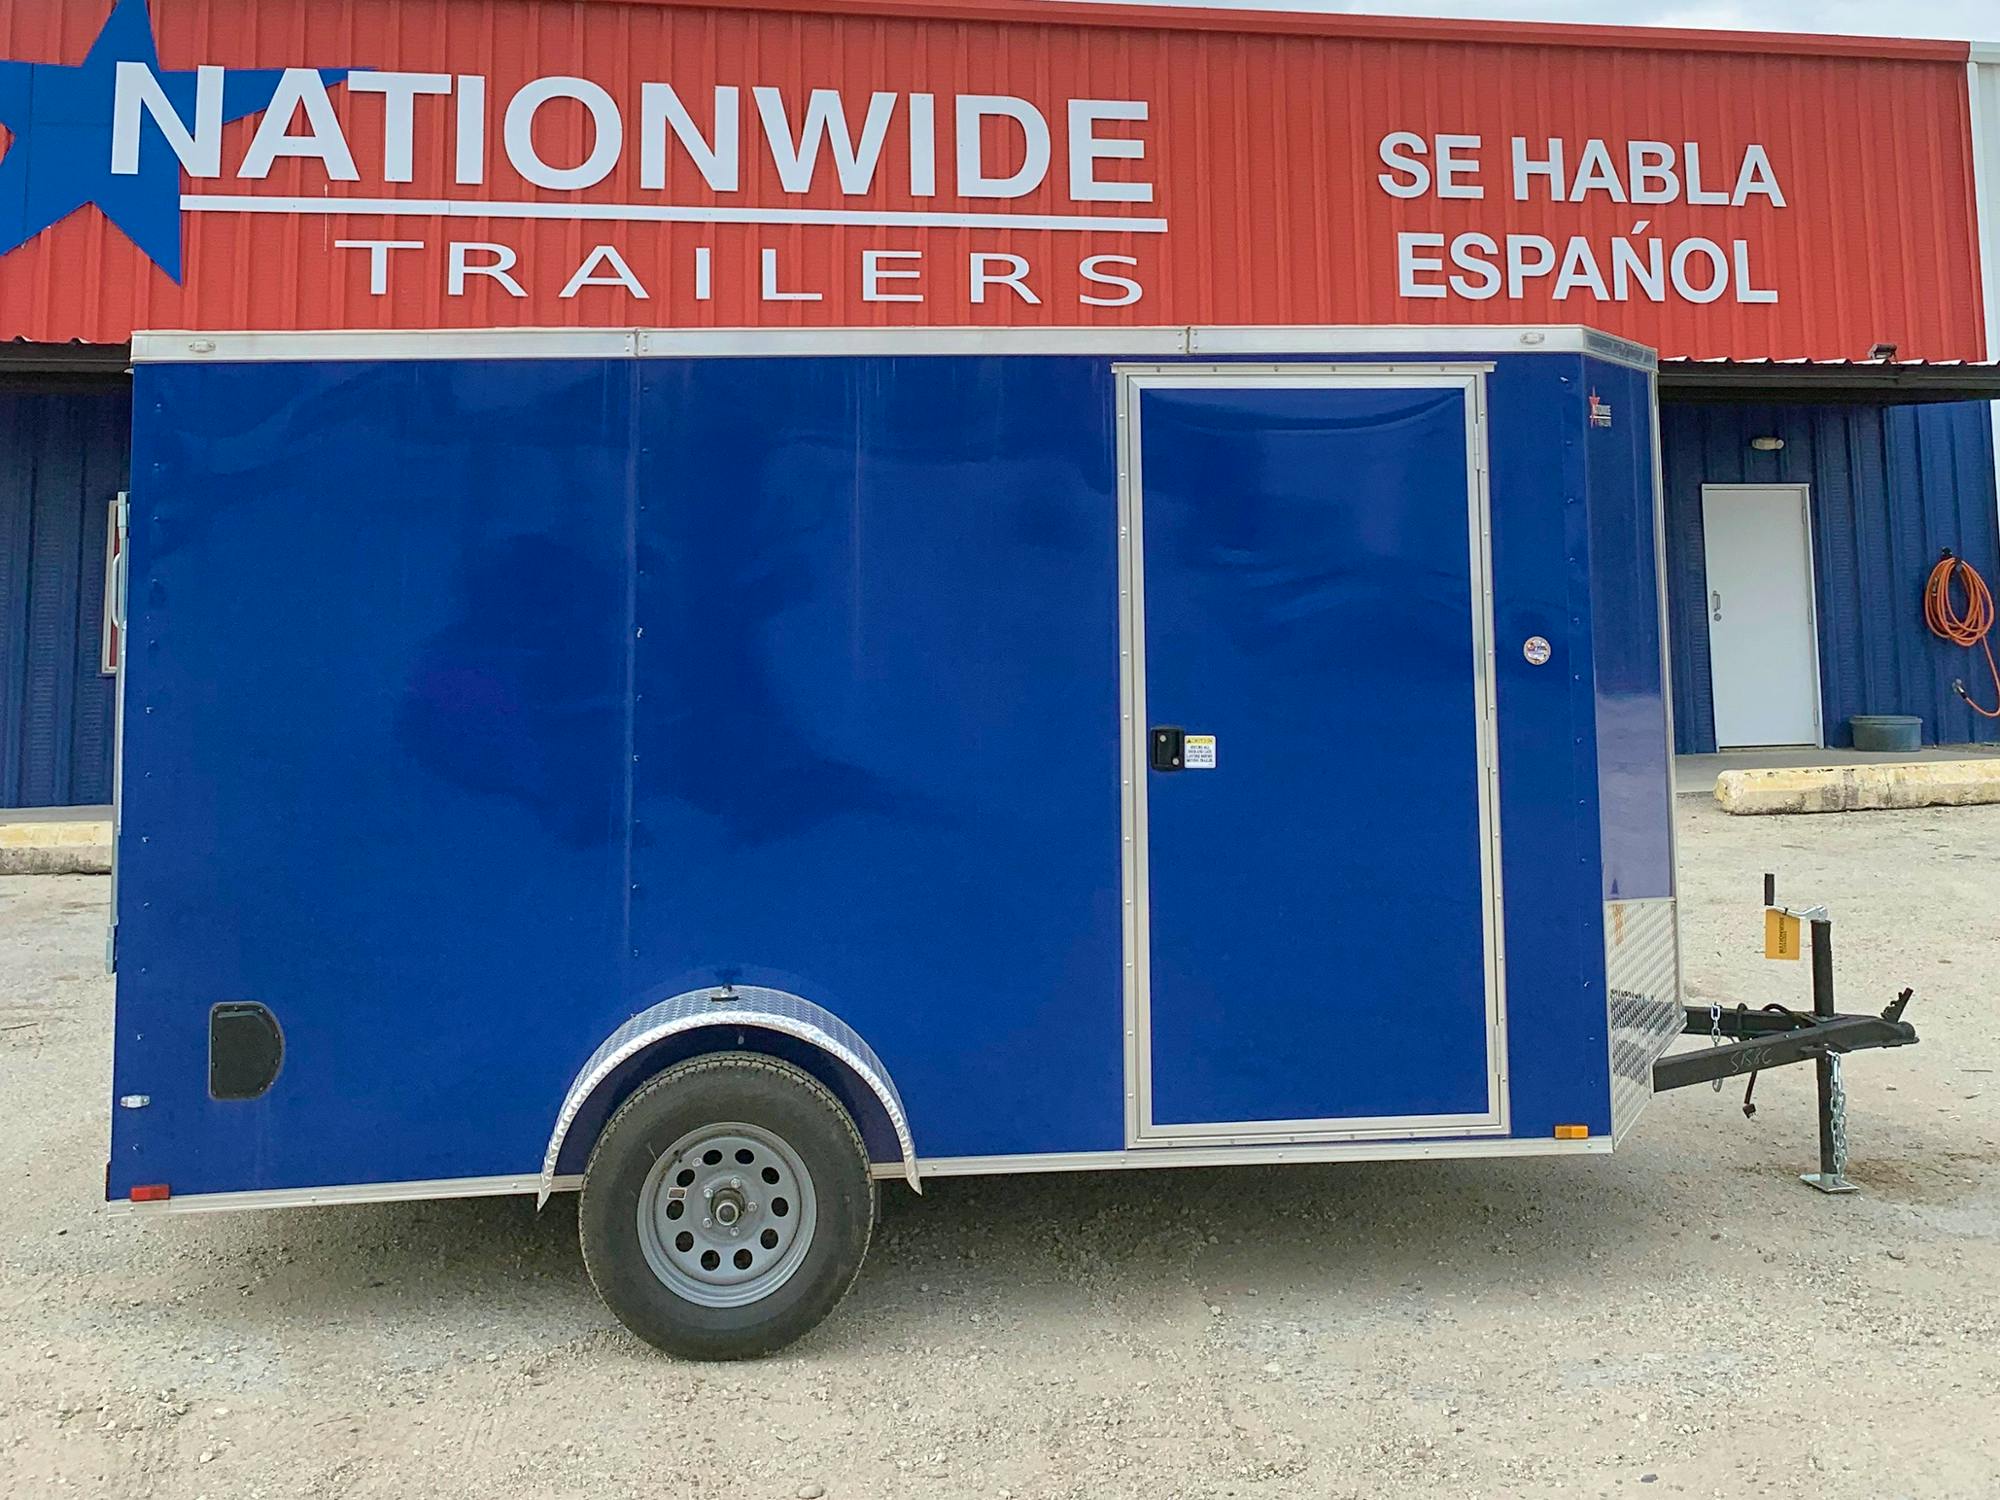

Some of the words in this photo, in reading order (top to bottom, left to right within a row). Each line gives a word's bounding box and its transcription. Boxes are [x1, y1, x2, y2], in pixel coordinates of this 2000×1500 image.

[111, 61, 1153, 202] NATIONWIDE
[1378, 131, 1484, 199] SE
[1511, 136, 1787, 207] HABLA
[334, 240, 1143, 306] TRAILERS
